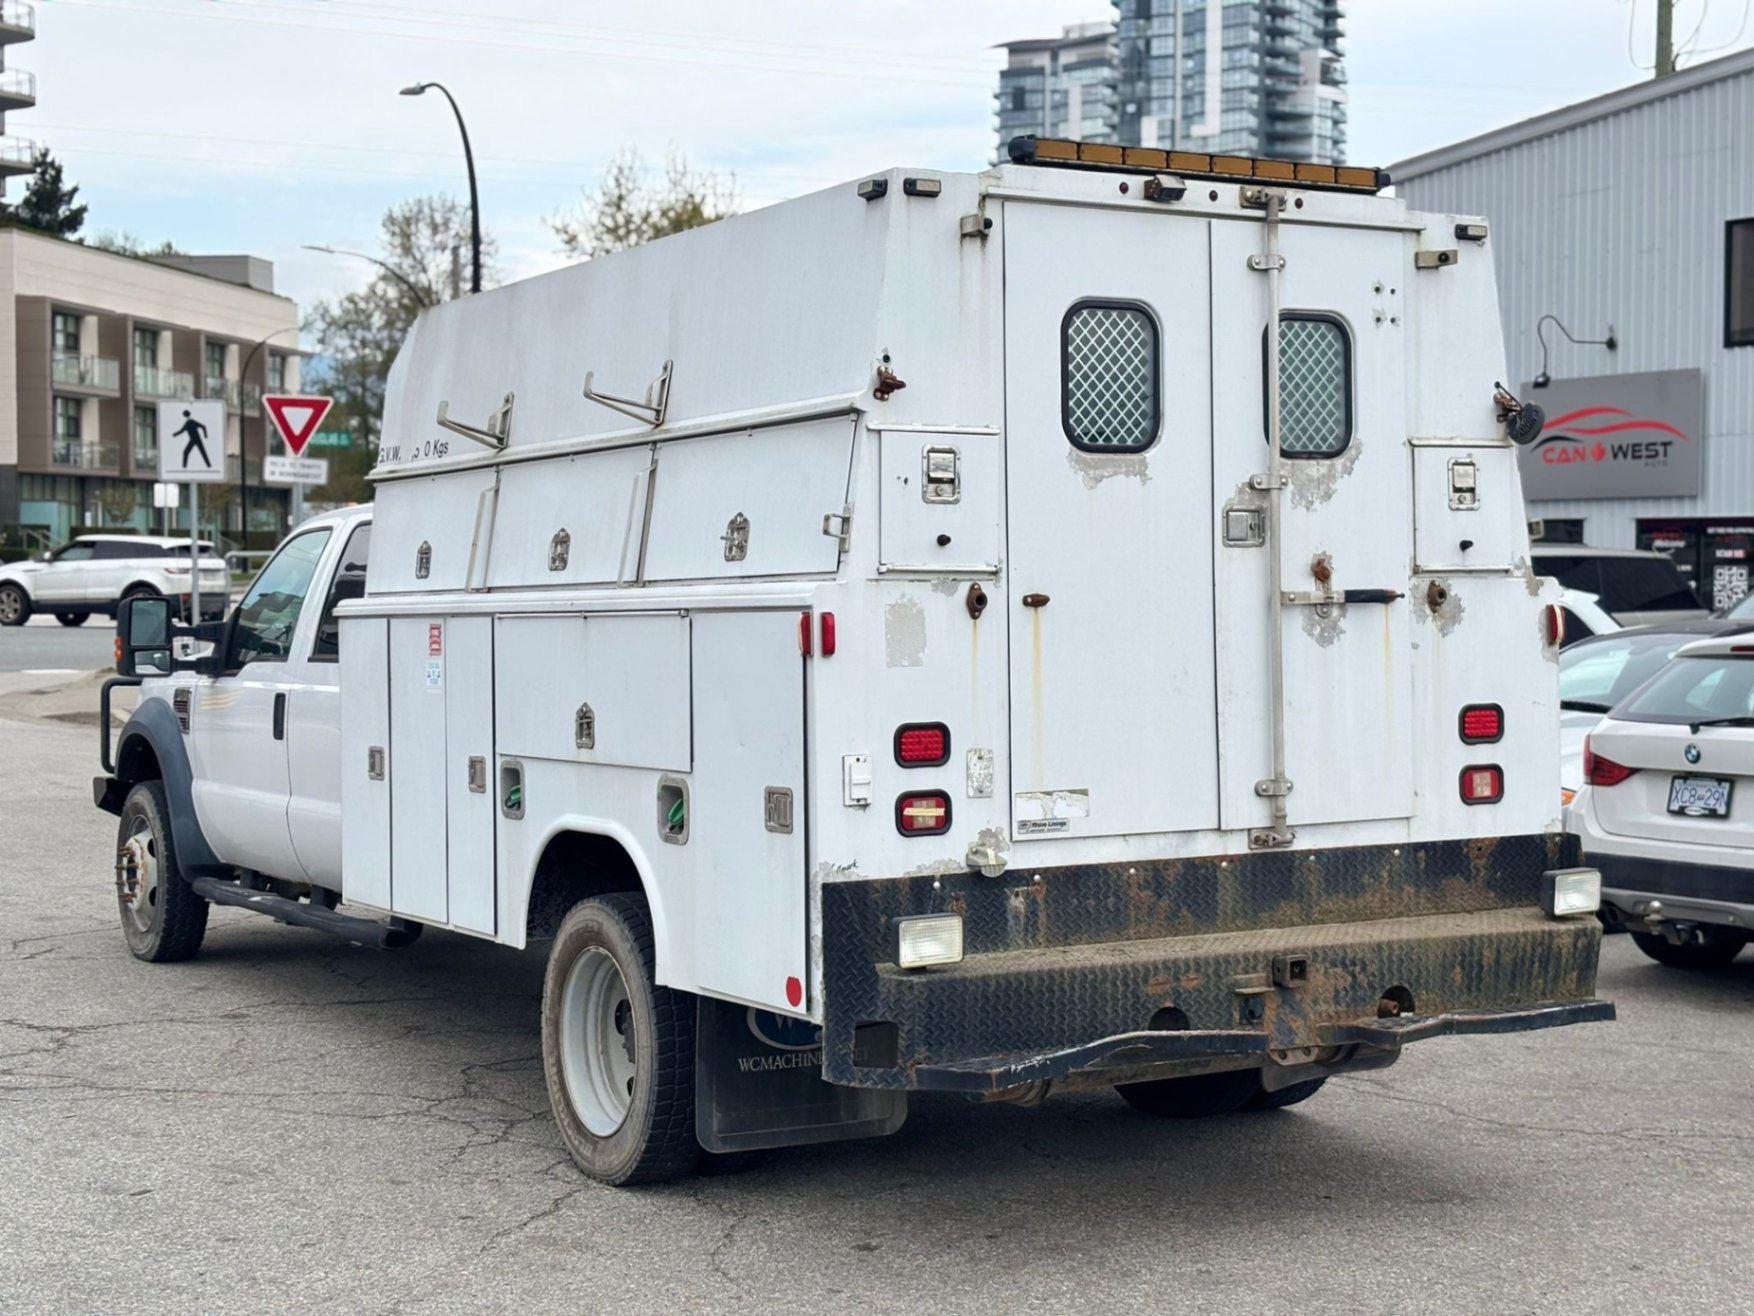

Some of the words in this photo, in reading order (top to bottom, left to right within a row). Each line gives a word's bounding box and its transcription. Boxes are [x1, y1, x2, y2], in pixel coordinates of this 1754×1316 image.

[433, 439, 449, 458] Kgs
[1542, 446, 1587, 464] CAN
[1611, 441, 1673, 460] WEST
